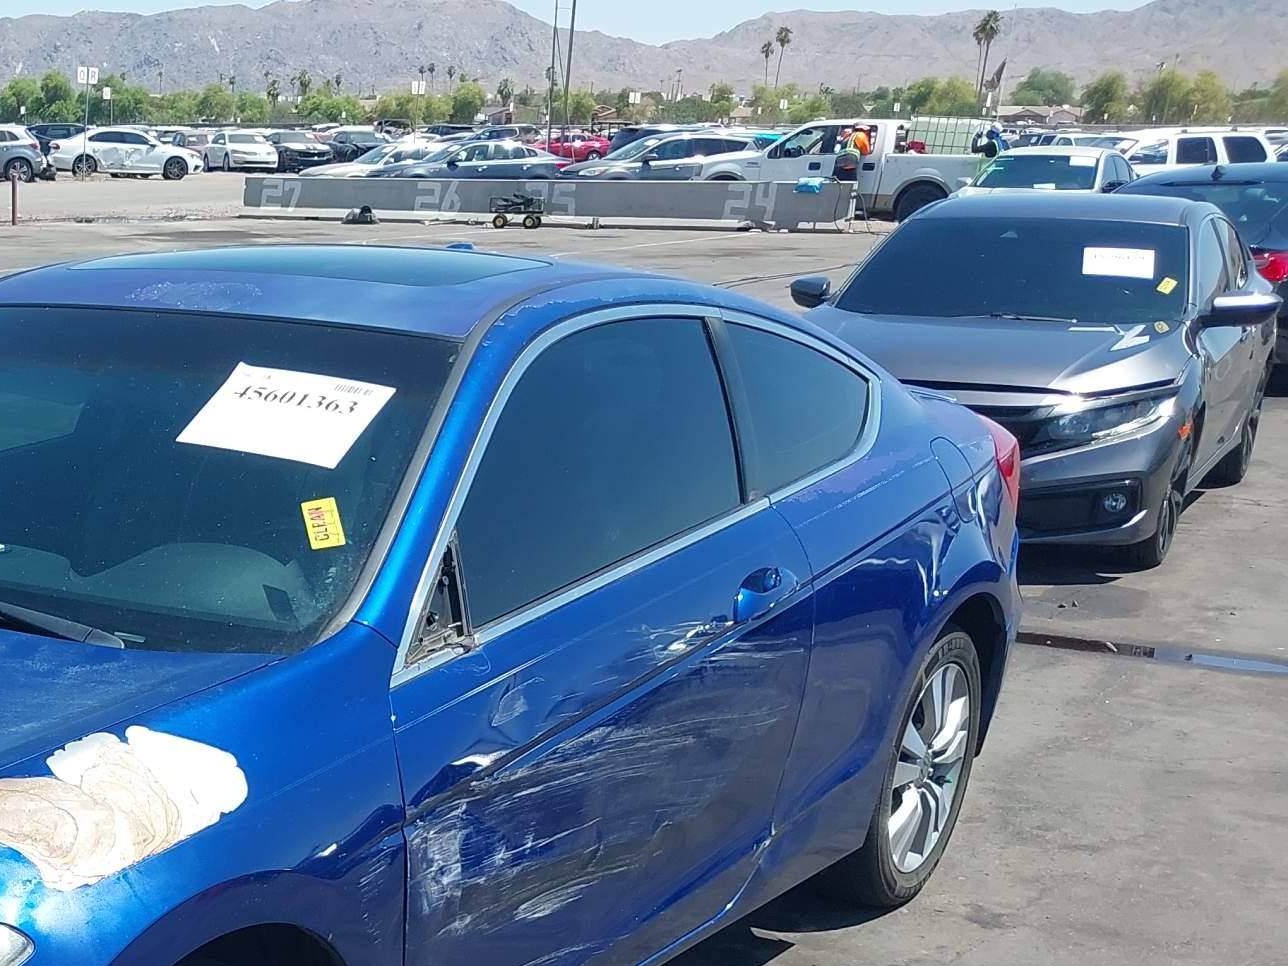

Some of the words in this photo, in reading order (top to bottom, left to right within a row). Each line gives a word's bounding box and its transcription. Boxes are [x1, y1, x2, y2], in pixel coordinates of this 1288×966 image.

[260, 179, 302, 212] 27
[414, 180, 461, 212] 26
[721, 182, 777, 222] 24
[233, 385, 359, 414] 45601363
